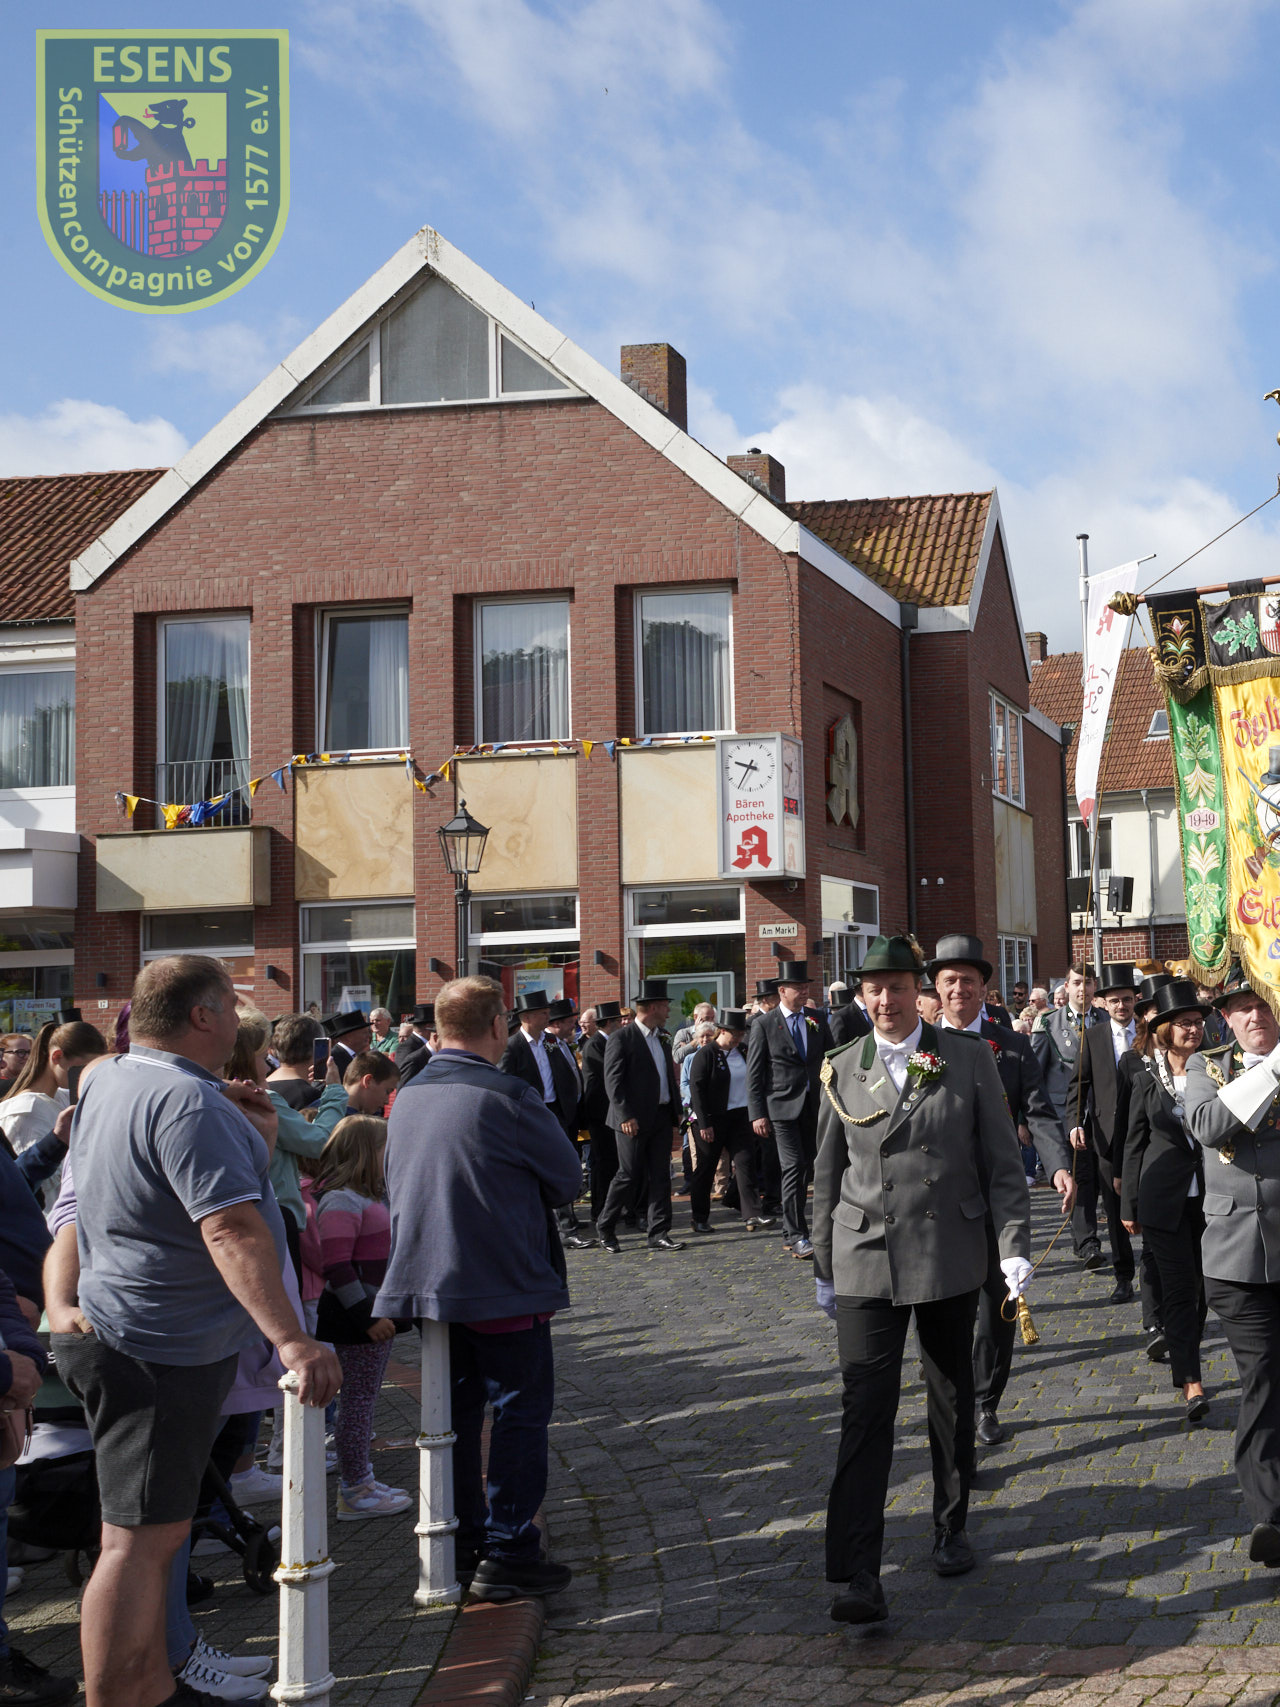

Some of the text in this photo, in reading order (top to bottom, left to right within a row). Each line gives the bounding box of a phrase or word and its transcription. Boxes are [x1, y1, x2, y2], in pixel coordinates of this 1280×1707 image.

[735, 799, 765, 809] Bären
[726, 811, 775, 823] Apotheke
[1188, 811, 1215, 827] 1949
[762, 925, 795, 935] Am Markt
